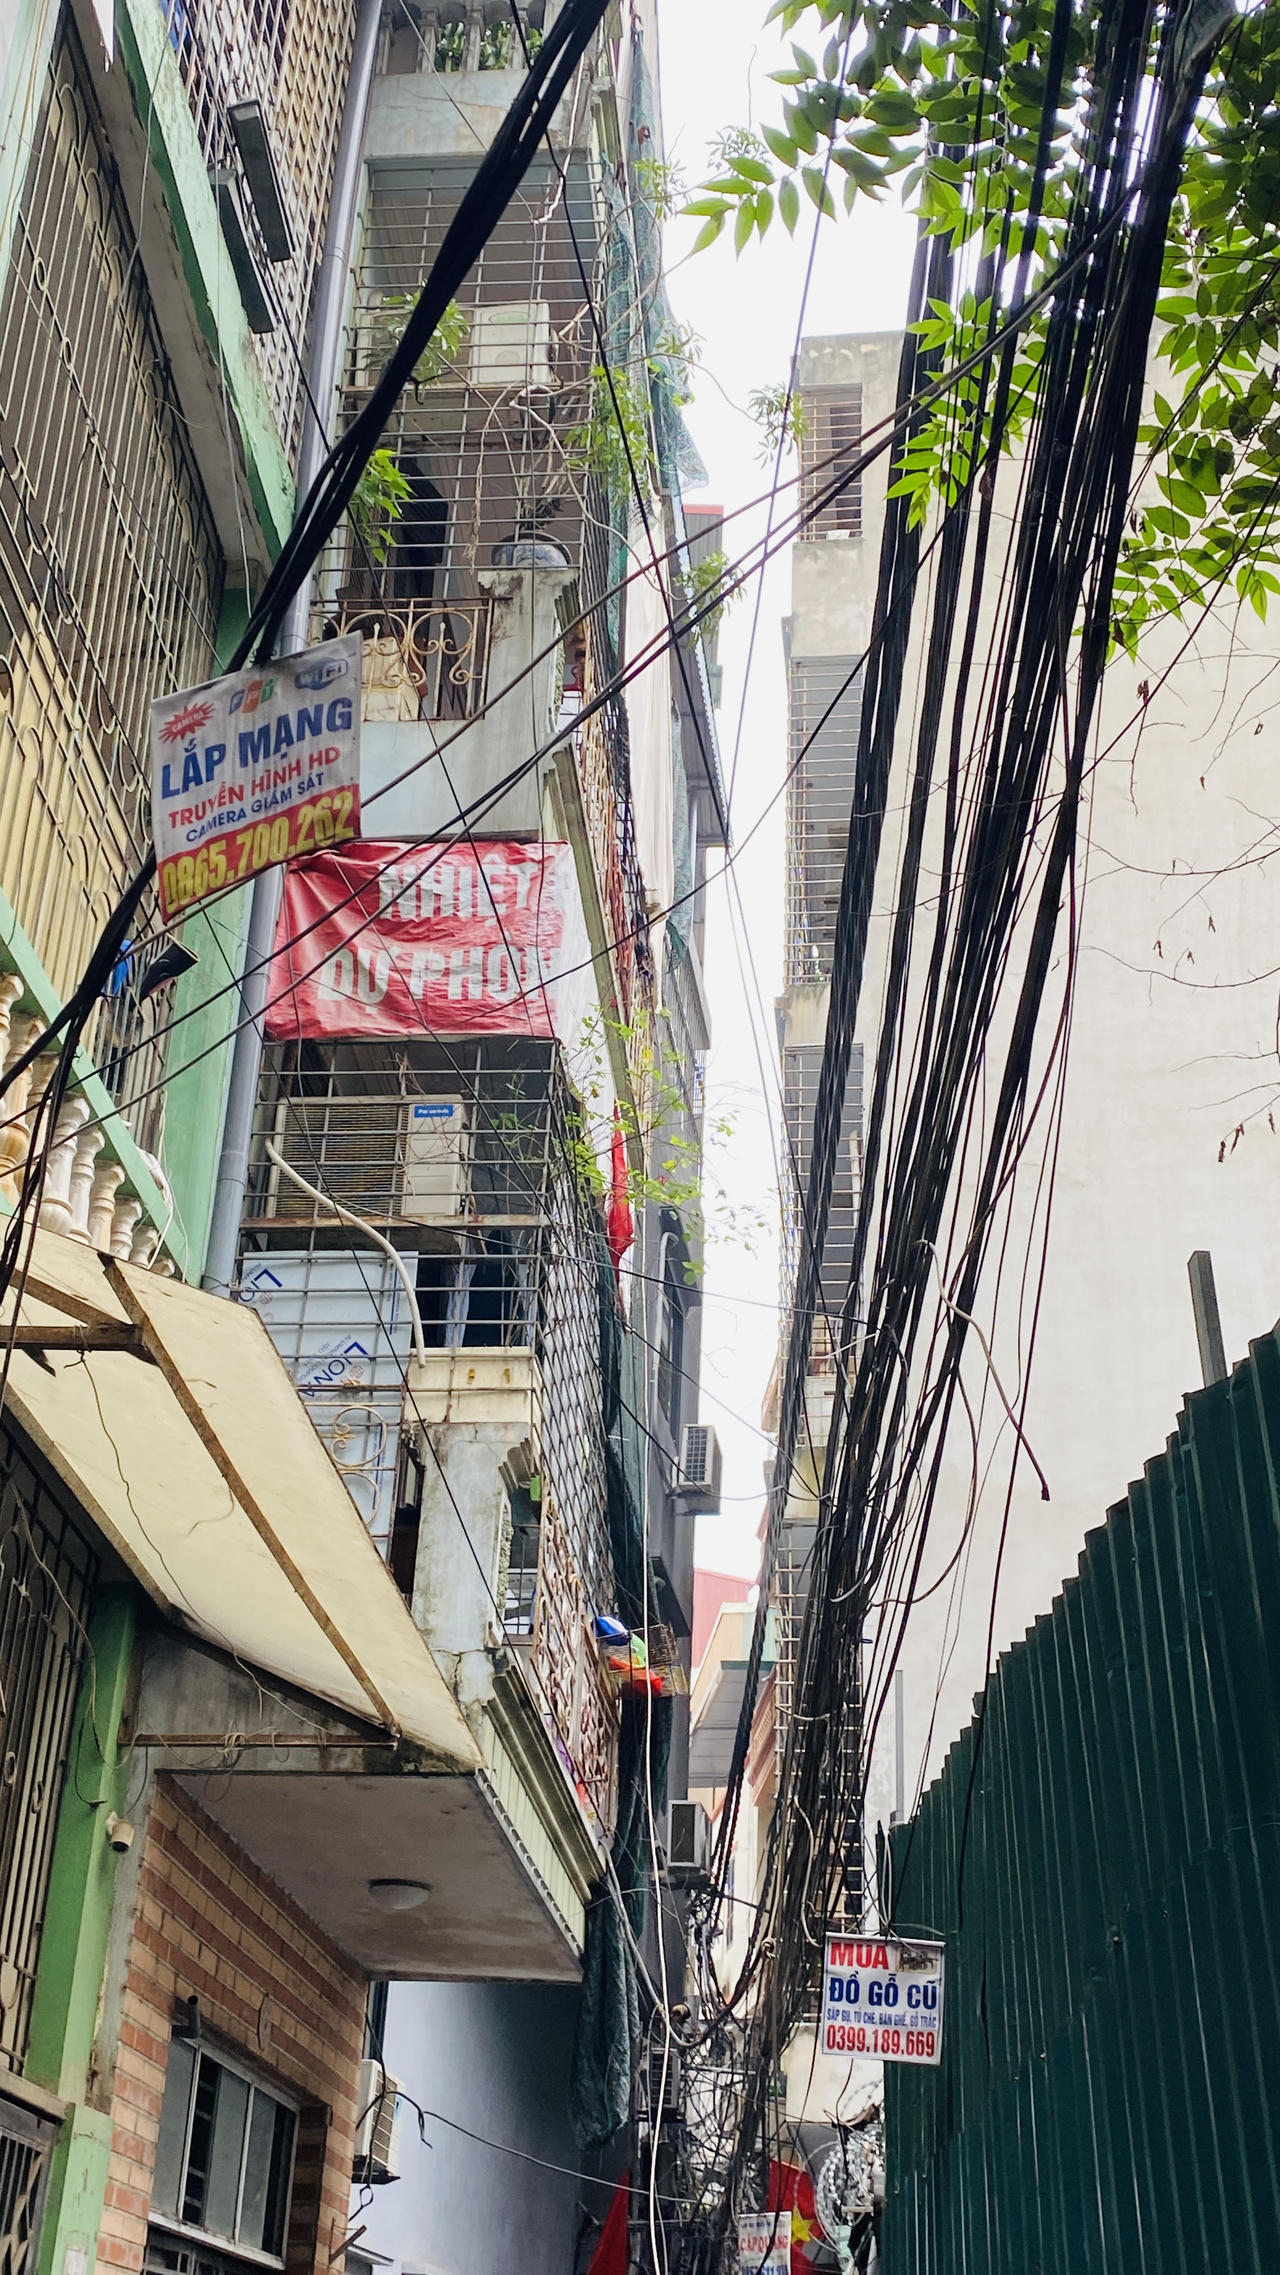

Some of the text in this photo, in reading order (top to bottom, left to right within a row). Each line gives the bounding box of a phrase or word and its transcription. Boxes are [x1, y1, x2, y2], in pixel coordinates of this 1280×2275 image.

[171, 710, 204, 733] CAMERA
[228, 676, 277, 716] FPT
[162, 696, 354, 800] LẮP MẠNG
[250, 755, 302, 798] HÌNH
[308, 745, 341, 771] HD
[185, 771, 325, 843] CAMERA GIÁM SÁT
[162, 790, 355, 914] 0865.700.262
[378, 853, 541, 927] NHIỆT
[317, 945, 399, 1015] DỰ
[830, 1942, 890, 1970] MUA
[829, 1971, 937, 2010] ĐỒ GỖ CŨ
[826, 2024, 935, 2058] 0399.189.669
